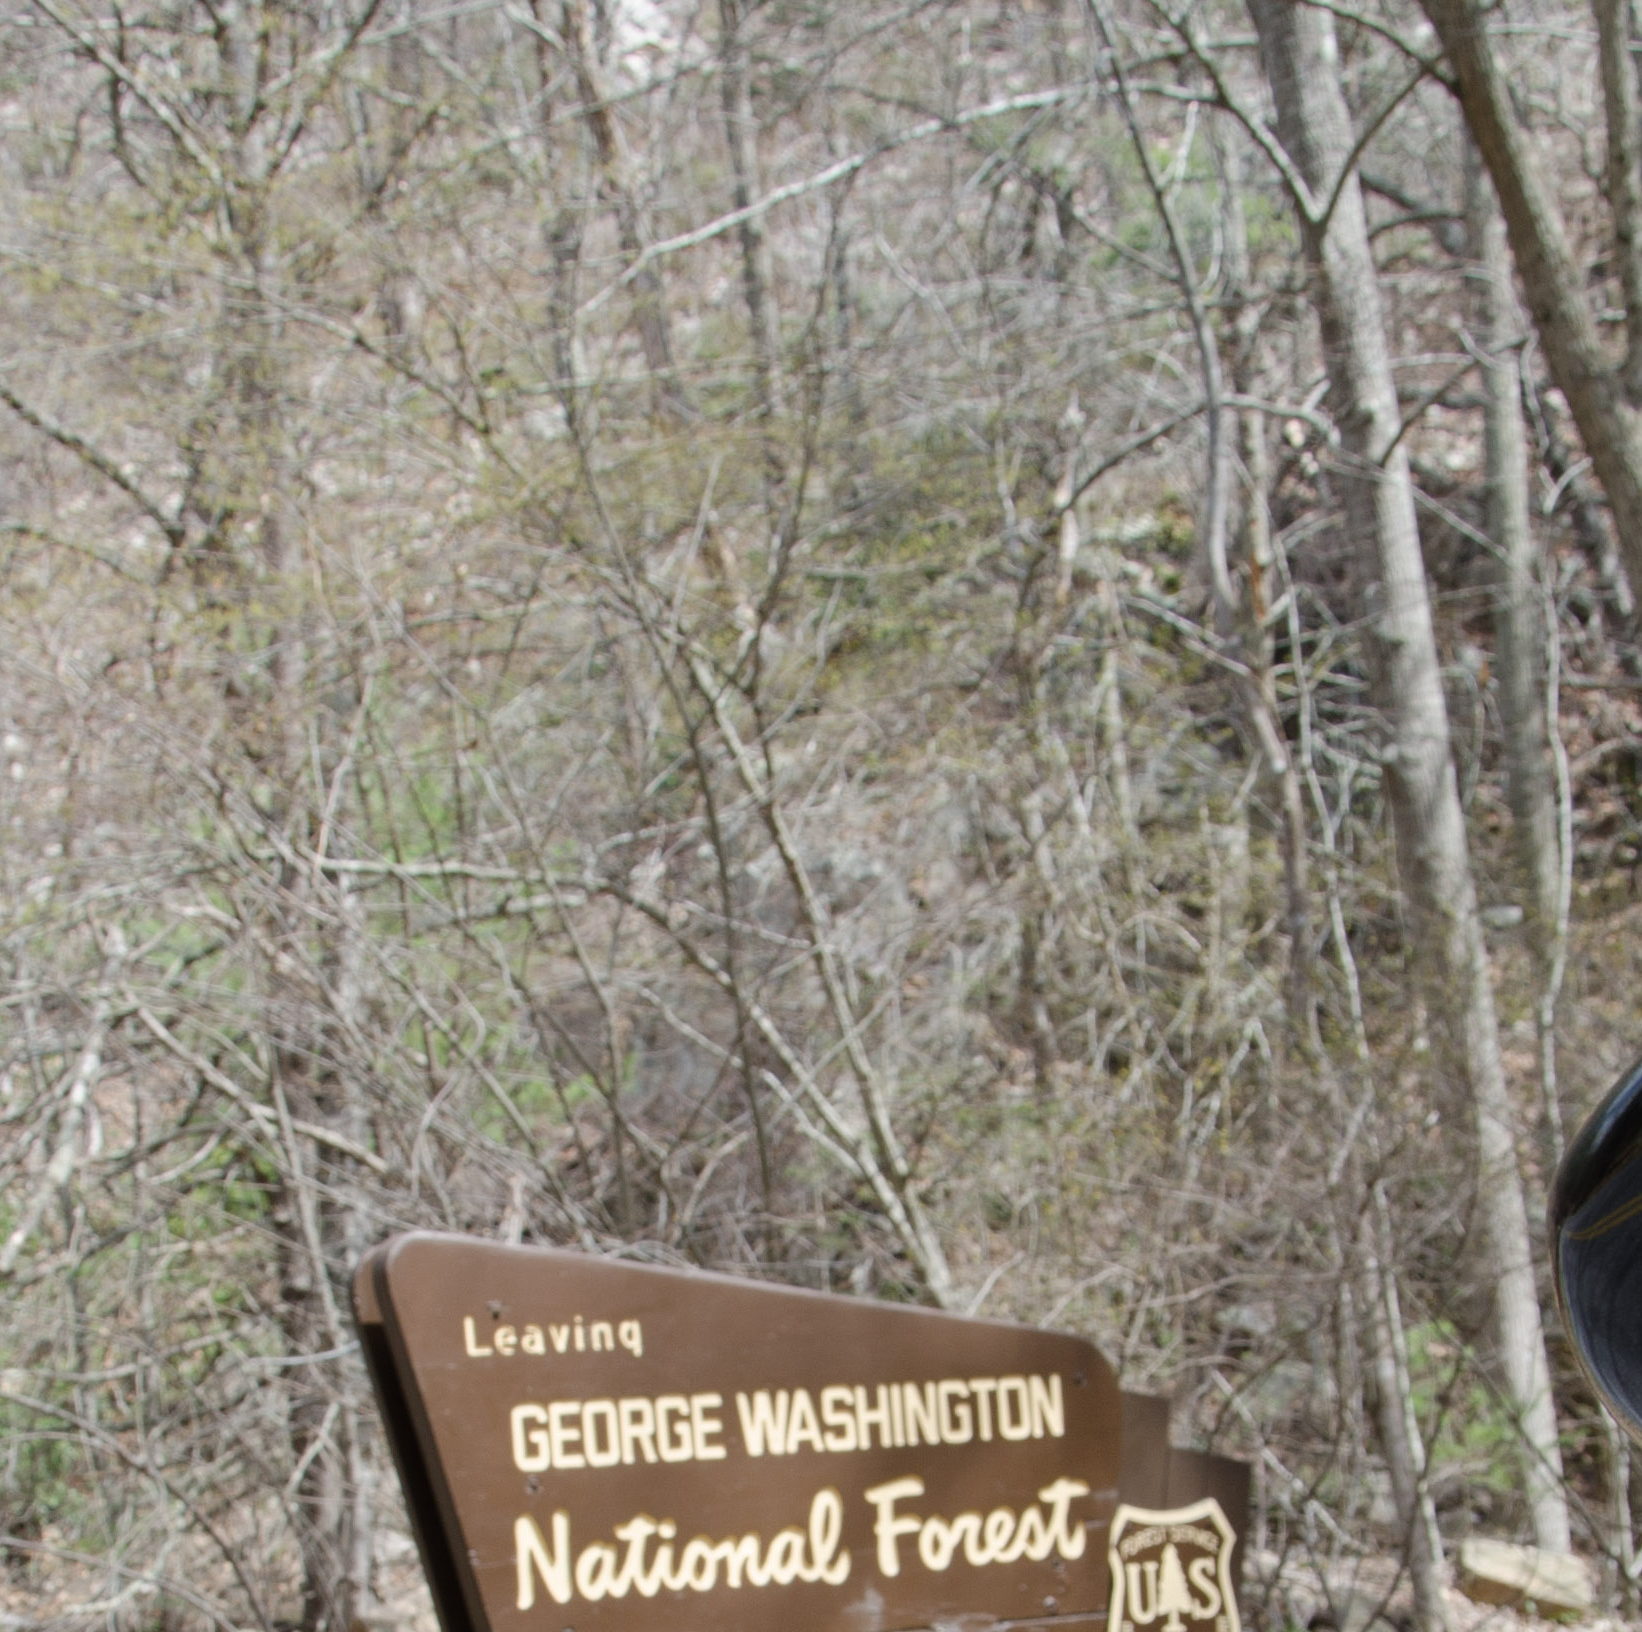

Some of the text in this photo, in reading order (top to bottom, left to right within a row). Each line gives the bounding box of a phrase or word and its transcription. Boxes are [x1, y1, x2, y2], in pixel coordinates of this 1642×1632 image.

[510, 1373, 1066, 1473] GEORGE WASHINGTON
[513, 1475, 1090, 1611] National Forest
